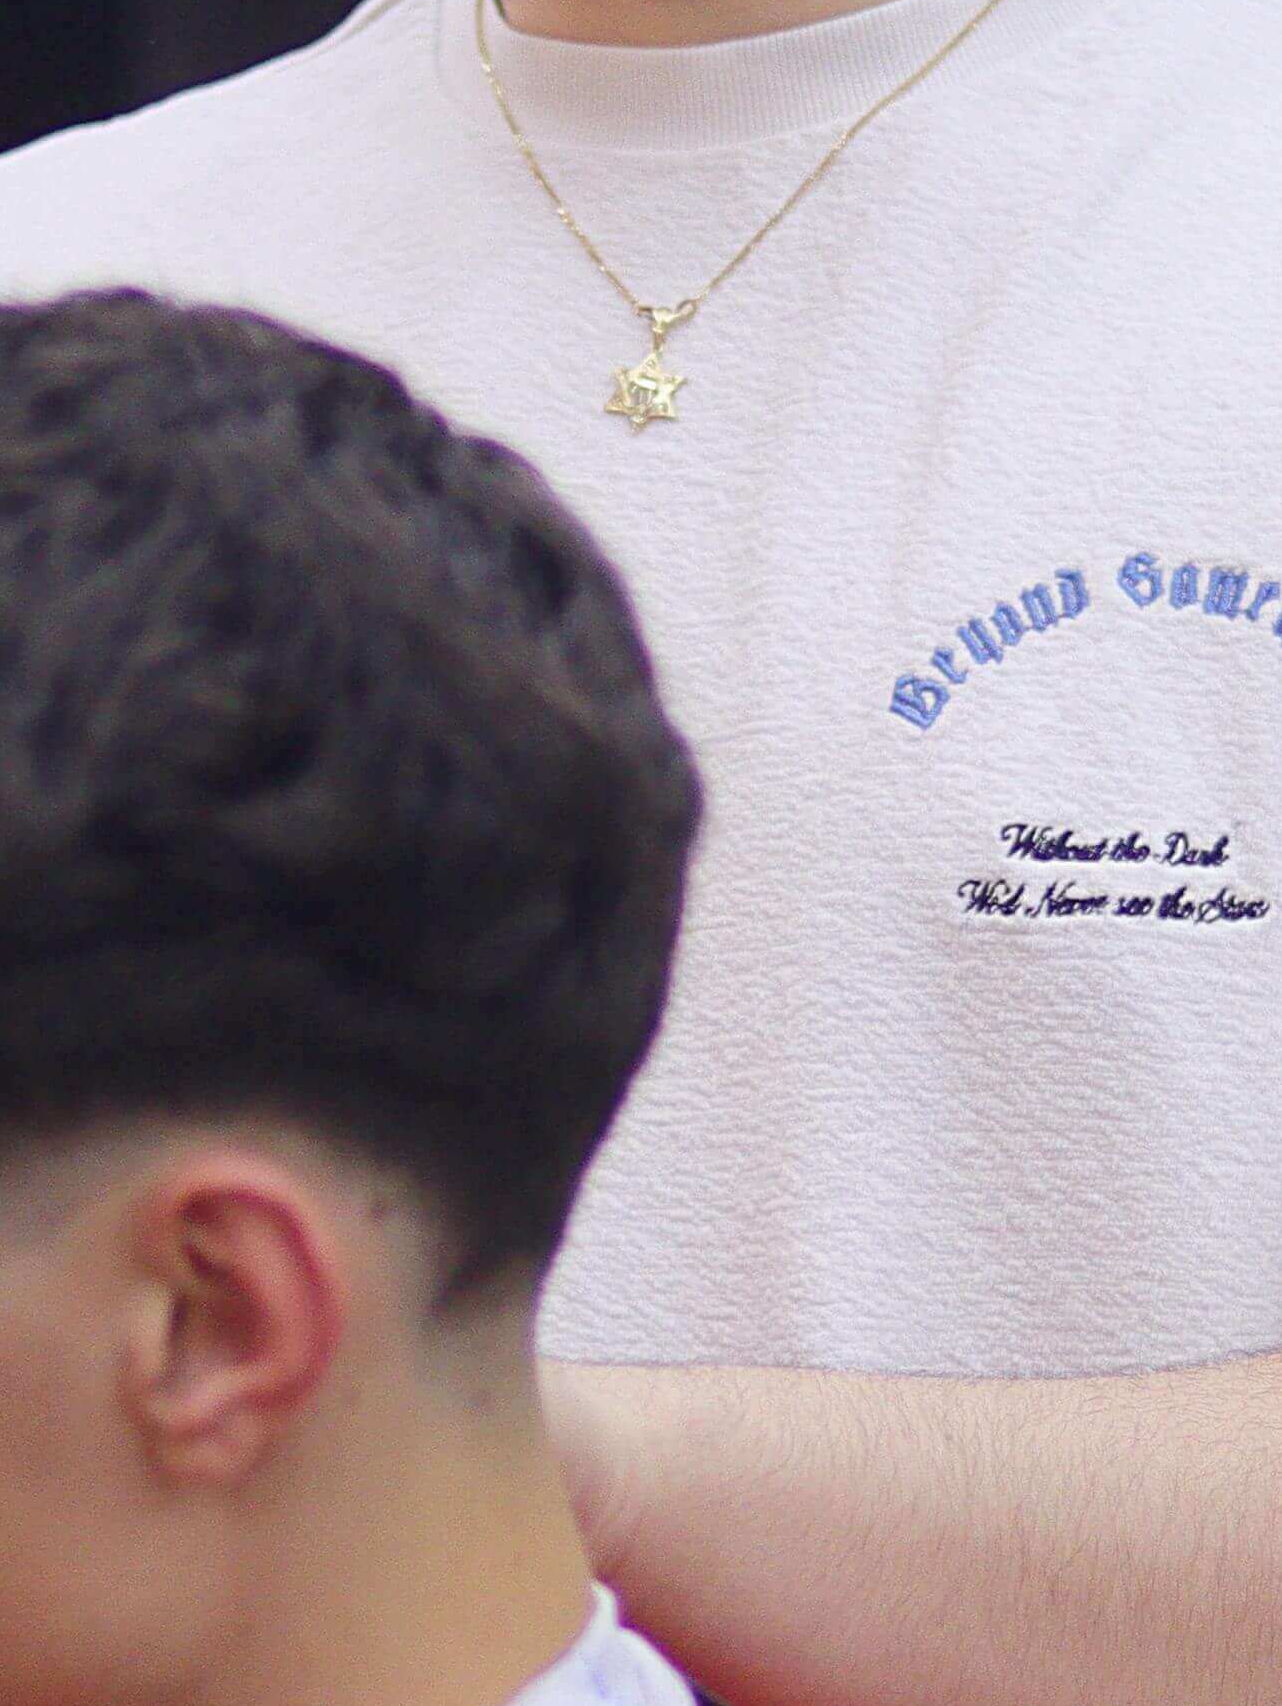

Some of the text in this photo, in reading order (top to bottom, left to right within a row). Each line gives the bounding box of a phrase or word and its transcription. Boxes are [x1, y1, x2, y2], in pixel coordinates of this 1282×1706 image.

[889, 568, 1091, 731] Beyond
[1000, 822, 1230, 866] Without the Dark
[1024, 878, 1109, 918] Never
[1112, 895, 1155, 916] see
[1156, 884, 1195, 919] the
